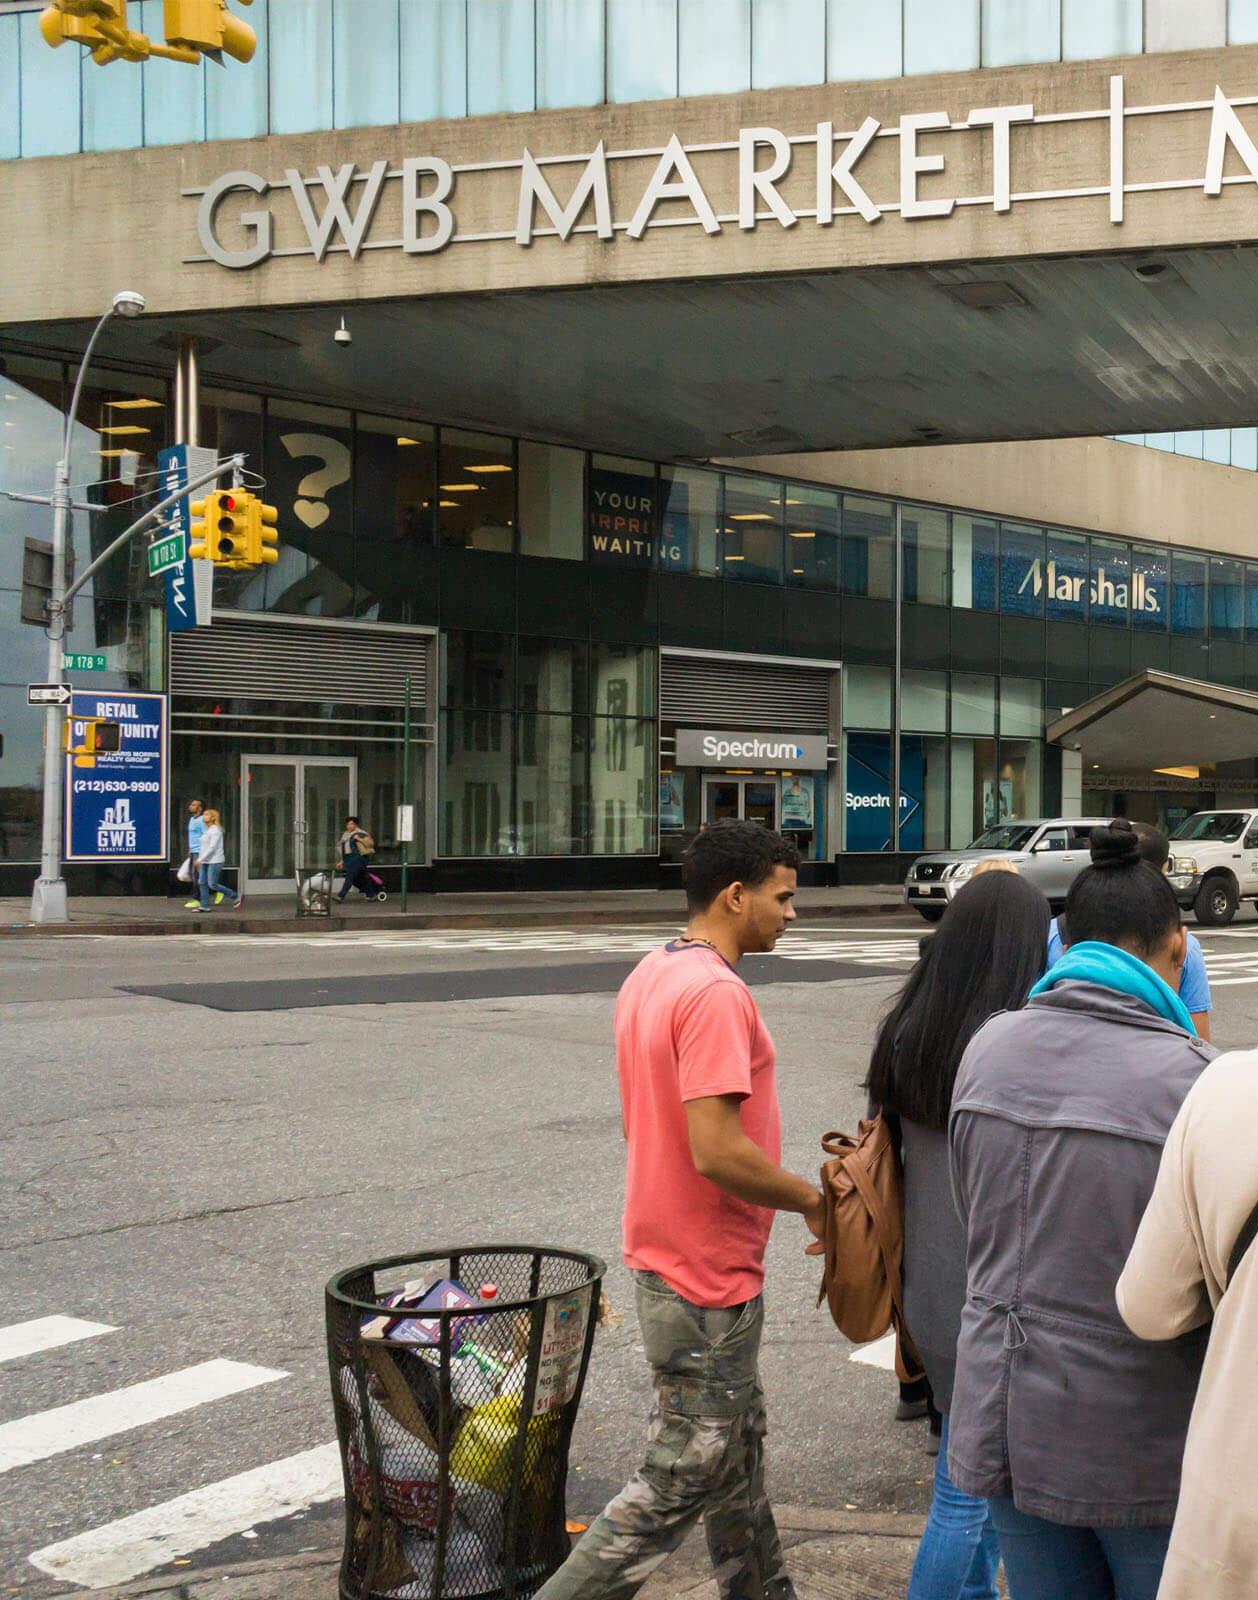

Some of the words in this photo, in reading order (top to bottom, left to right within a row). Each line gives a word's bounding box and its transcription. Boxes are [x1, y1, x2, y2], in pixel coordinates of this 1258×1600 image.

[197, 157, 456, 268] GWB
[515, 104, 1035, 246] MARKET
[594, 491, 652, 513] YOUR
[77, 656, 94, 669] 178
[96, 702, 139, 718] RETAIL
[75, 722, 160, 739] OTUNITY
[703, 736, 797, 760] Spectrum
[74, 780, 160, 793] (212)630-9900
[98, 831, 136, 847] GWB
